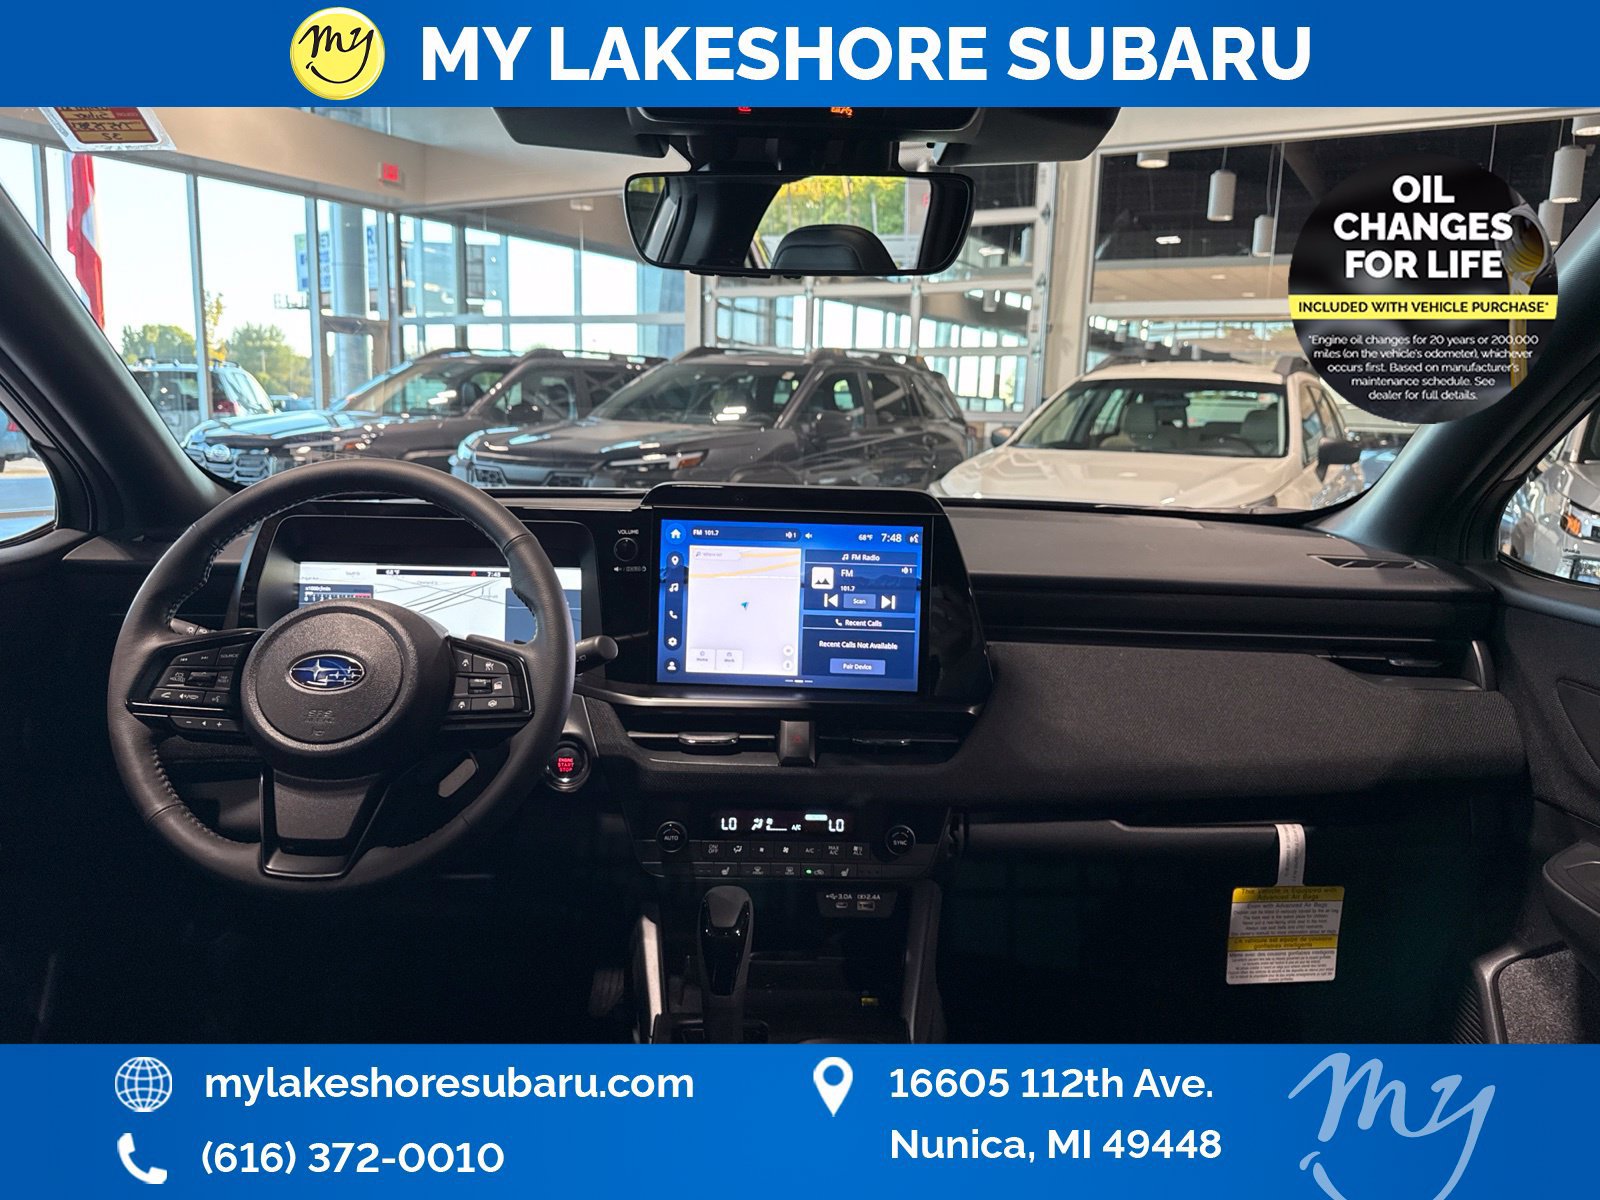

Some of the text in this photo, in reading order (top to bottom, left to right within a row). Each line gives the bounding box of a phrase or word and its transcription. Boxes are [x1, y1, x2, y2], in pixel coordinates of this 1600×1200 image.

[880, 533, 902, 542] 7:48
[840, 569, 854, 578] FM
[819, 640, 839, 648] Recent
[840, 641, 856, 649] Calls
[869, 642, 898, 650] Available
[720, 818, 737, 831] LO
[828, 819, 845, 832] LO
